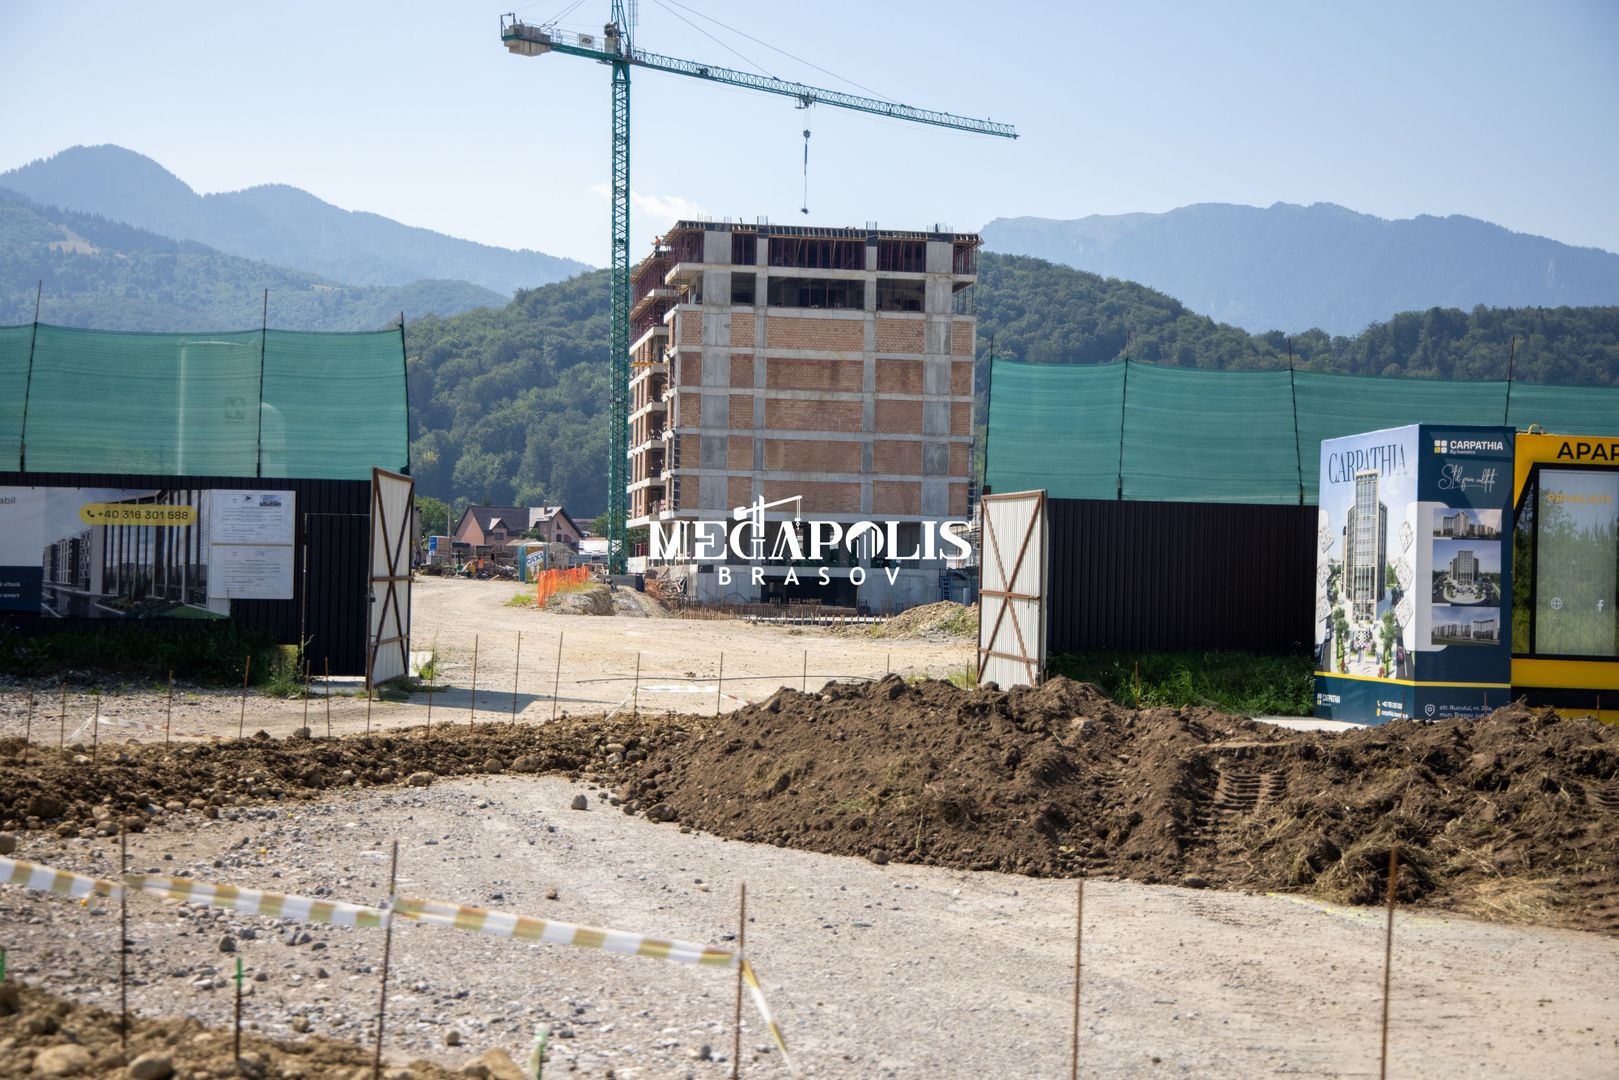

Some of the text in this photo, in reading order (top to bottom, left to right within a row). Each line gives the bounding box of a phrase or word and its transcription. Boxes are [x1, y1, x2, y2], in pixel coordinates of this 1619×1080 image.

[1450, 440, 1504, 450] CARPATHIA
[1328, 442, 1408, 484] CARPATHIA
[98, 510, 189, 520] +40 316 301 588
